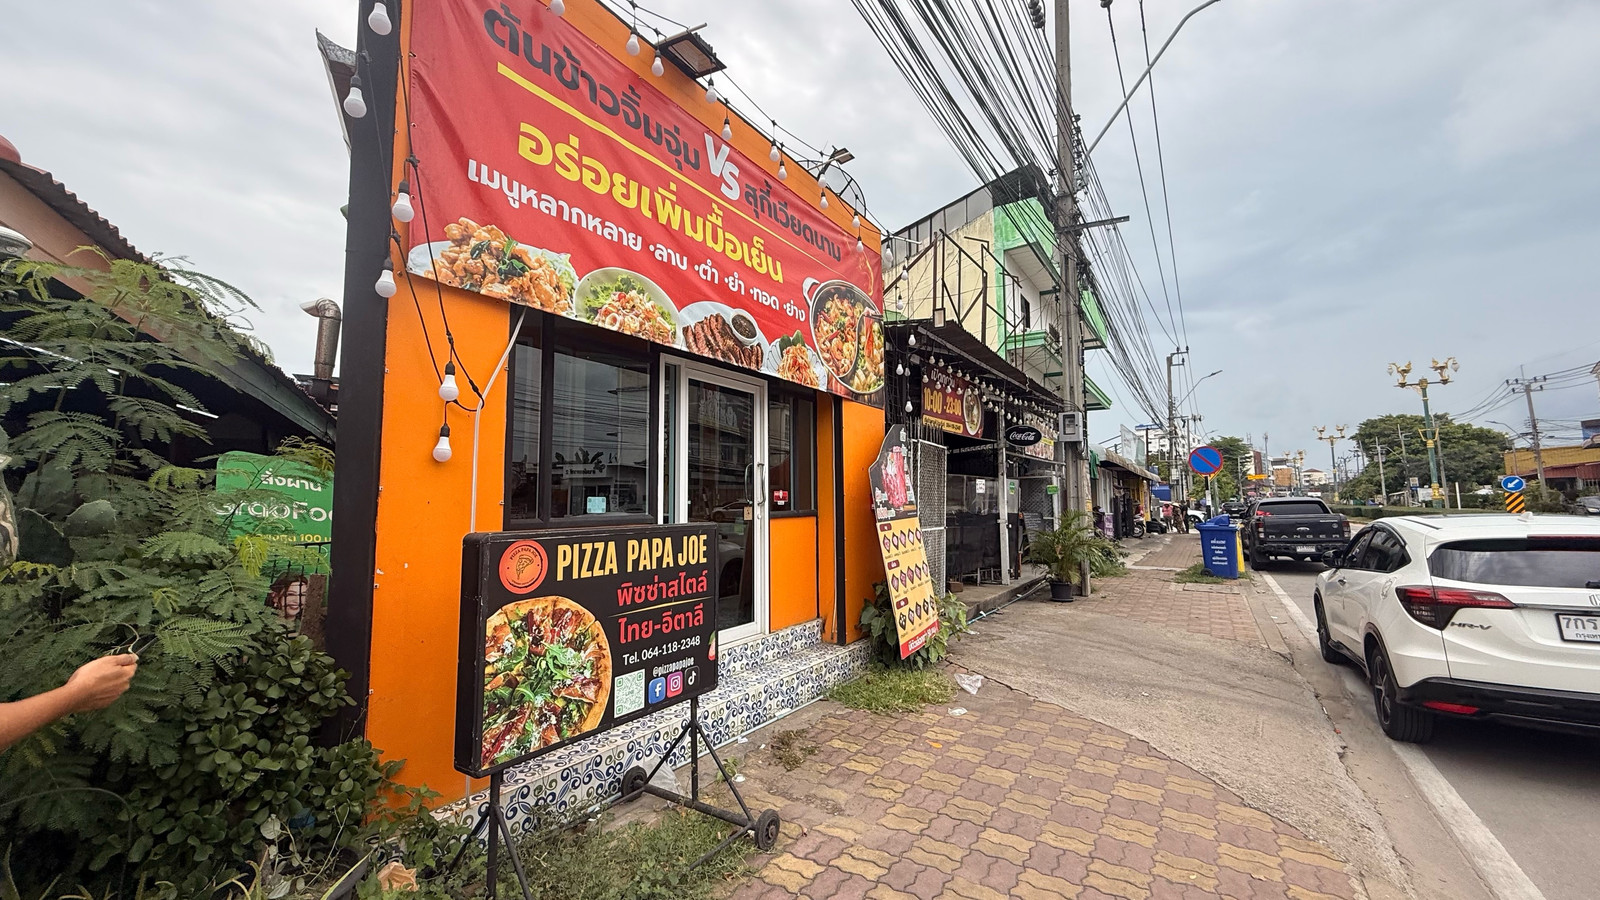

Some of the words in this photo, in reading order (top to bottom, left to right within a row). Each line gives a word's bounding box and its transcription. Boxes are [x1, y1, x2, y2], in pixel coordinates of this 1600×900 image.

[483, 3, 700, 171] ต้นข้าวจิ้มจุ่ม
[704, 132, 740, 200] VS
[744, 179, 841, 262] สุกี้เวียดนาม
[518, 121, 784, 284] อร่อยเพิ่มมื้อเย็น
[467, 158, 642, 252] เมนูหลากหลาย
[653, 243, 688, 271] ลาบ
[752, 286, 780, 311] ทอด
[924, 387, 943, 414] 10:00
[208, 496, 332, 522] GrabFo
[300, 534, 322, 543] 100
[556, 541, 618, 581] PIZZA
[626, 537, 674, 573] PAPA
[677, 534, 707, 567] JOE
[617, 569, 708, 607] พิซซ่าสไตล์
[1450, 621, 1492, 630] HR-V
[622, 651, 640, 666] Tel.
[641, 635, 701, 661] 064-118-2348
[652, 656, 695, 677] @pizzapapajoe
